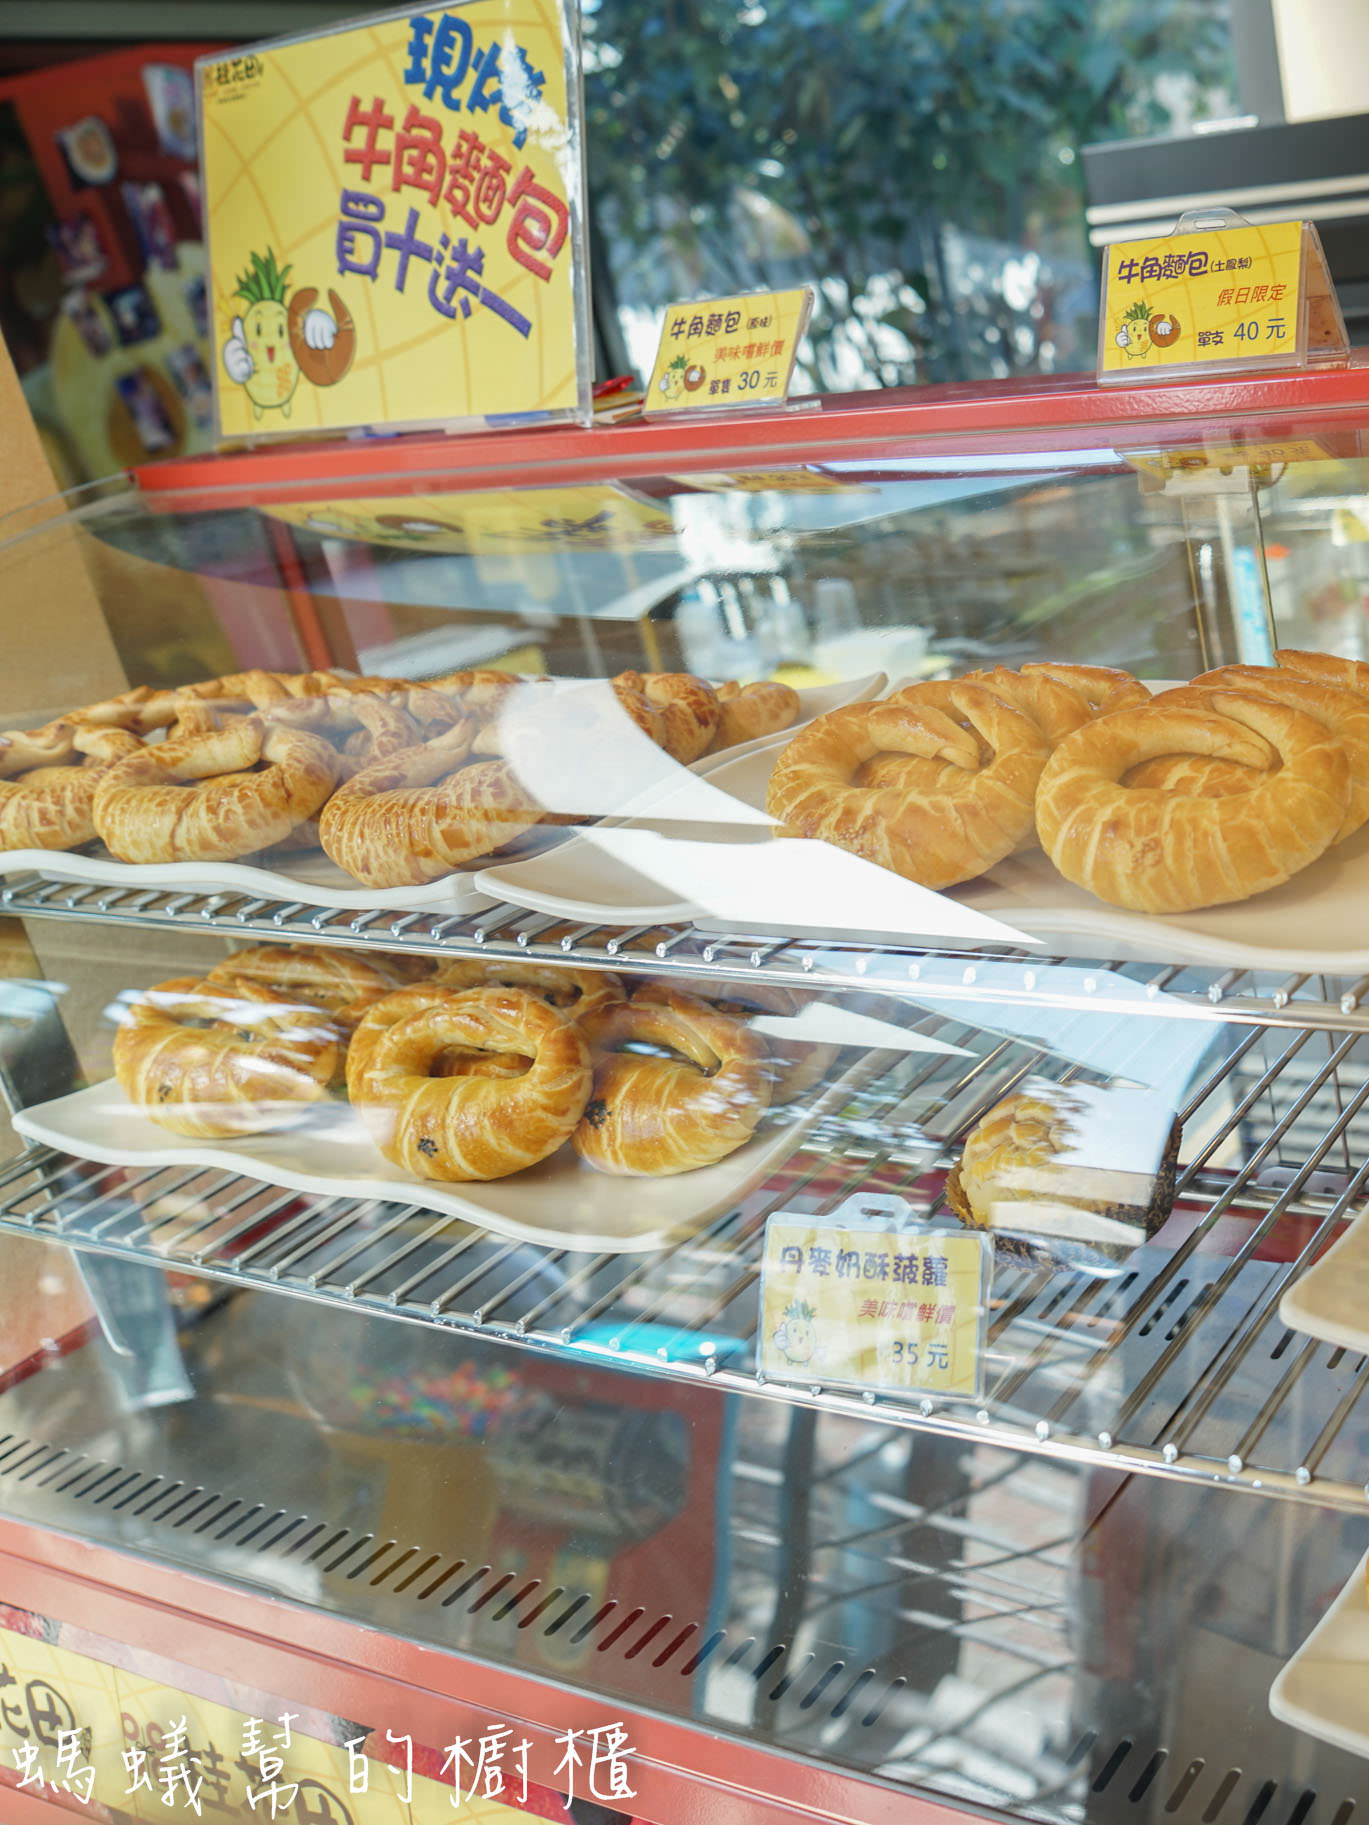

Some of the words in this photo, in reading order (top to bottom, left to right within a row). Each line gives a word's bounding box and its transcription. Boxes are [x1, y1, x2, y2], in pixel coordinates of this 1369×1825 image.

[342, 95, 570, 283] 牛角麵包
[336, 188, 532, 339] 買十送一
[1216, 284, 1287, 308] 假日限定
[669, 310, 741, 340] 牛角麵包
[1233, 321, 1260, 342] 40
[1265, 317, 1287, 340] 元
[737, 370, 760, 390] 30
[763, 371, 780, 389] 元
[780, 1246, 949, 1287] 丹麥奶酥菠蘿
[892, 1341, 919, 1365] 35
[926, 1344, 949, 1370] 元
